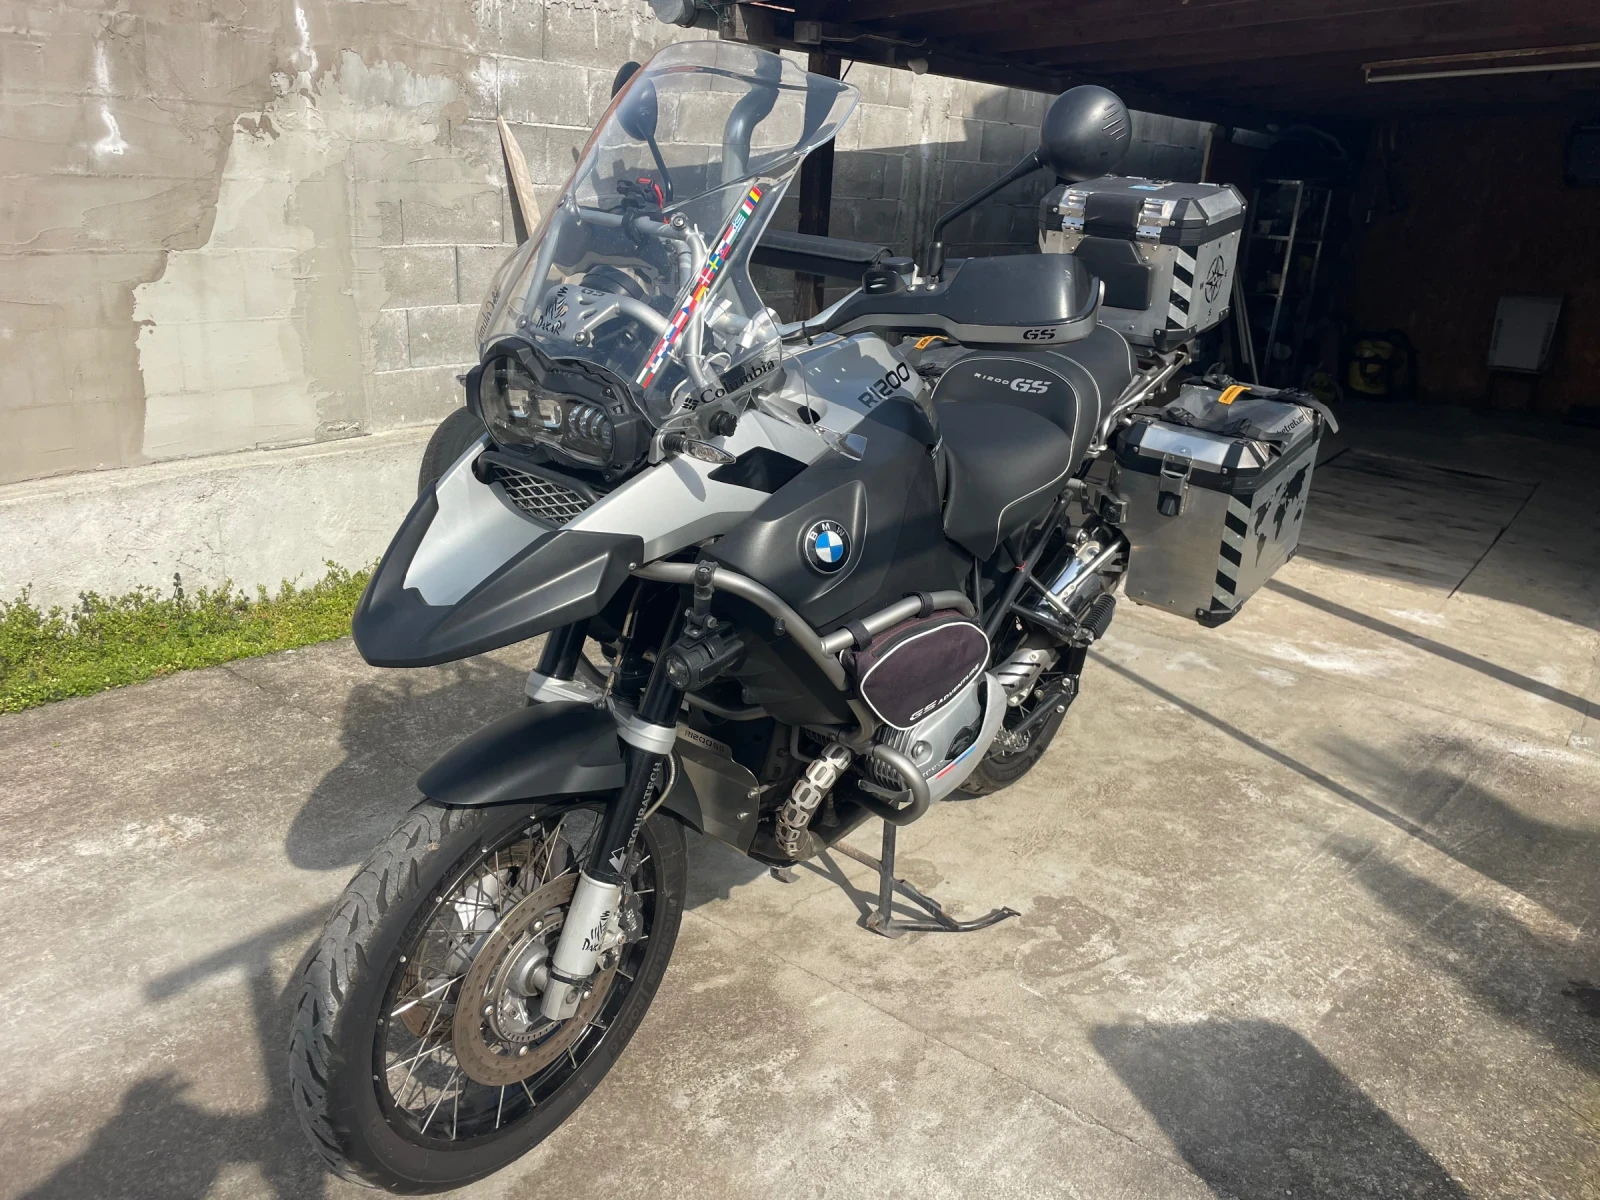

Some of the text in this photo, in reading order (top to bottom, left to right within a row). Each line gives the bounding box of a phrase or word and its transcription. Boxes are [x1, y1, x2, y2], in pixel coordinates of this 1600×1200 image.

[1022, 328, 1056, 341] GS
[700, 359, 776, 404] Columbia
[857, 361, 911, 409] R1200
[1009, 377, 1052, 395] GS
[808, 521, 846, 541] BMW
[909, 699, 937, 721] GS
[627, 760, 664, 848] TOURATECH
